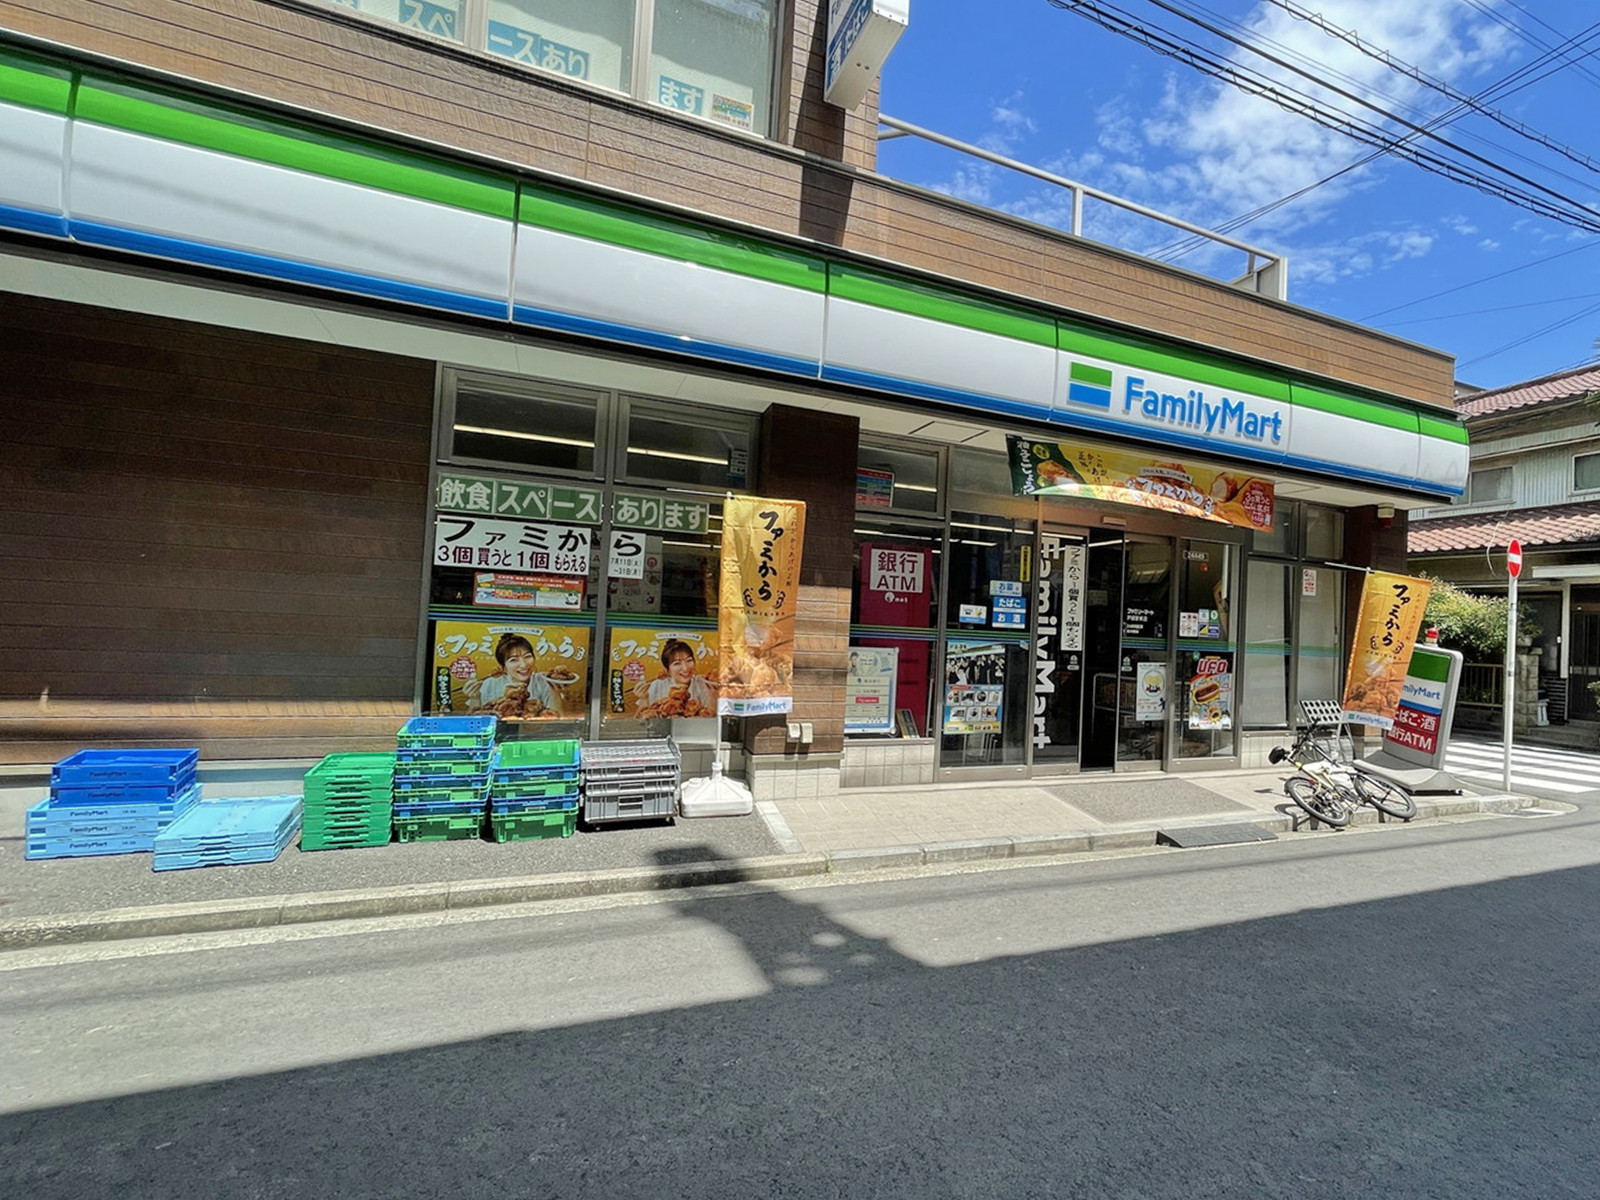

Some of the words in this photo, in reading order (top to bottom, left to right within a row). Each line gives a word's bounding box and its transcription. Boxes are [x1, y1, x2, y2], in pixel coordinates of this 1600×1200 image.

[1122, 375, 1283, 443] FamilyMart
[439, 479, 598, 521] 飲食スペース
[616, 497, 706, 530] あります
[439, 518, 588, 553] ファミか
[758, 511, 785, 602] ファミから
[876, 575, 916, 592] ATM
[877, 551, 918, 574] 銀行
[1382, 584, 1411, 647] ファミから
[1033, 538, 1060, 750] FamilyMart
[746, 702, 787, 711] FamilyMart
[1355, 714, 1389, 727] FamilyMart
